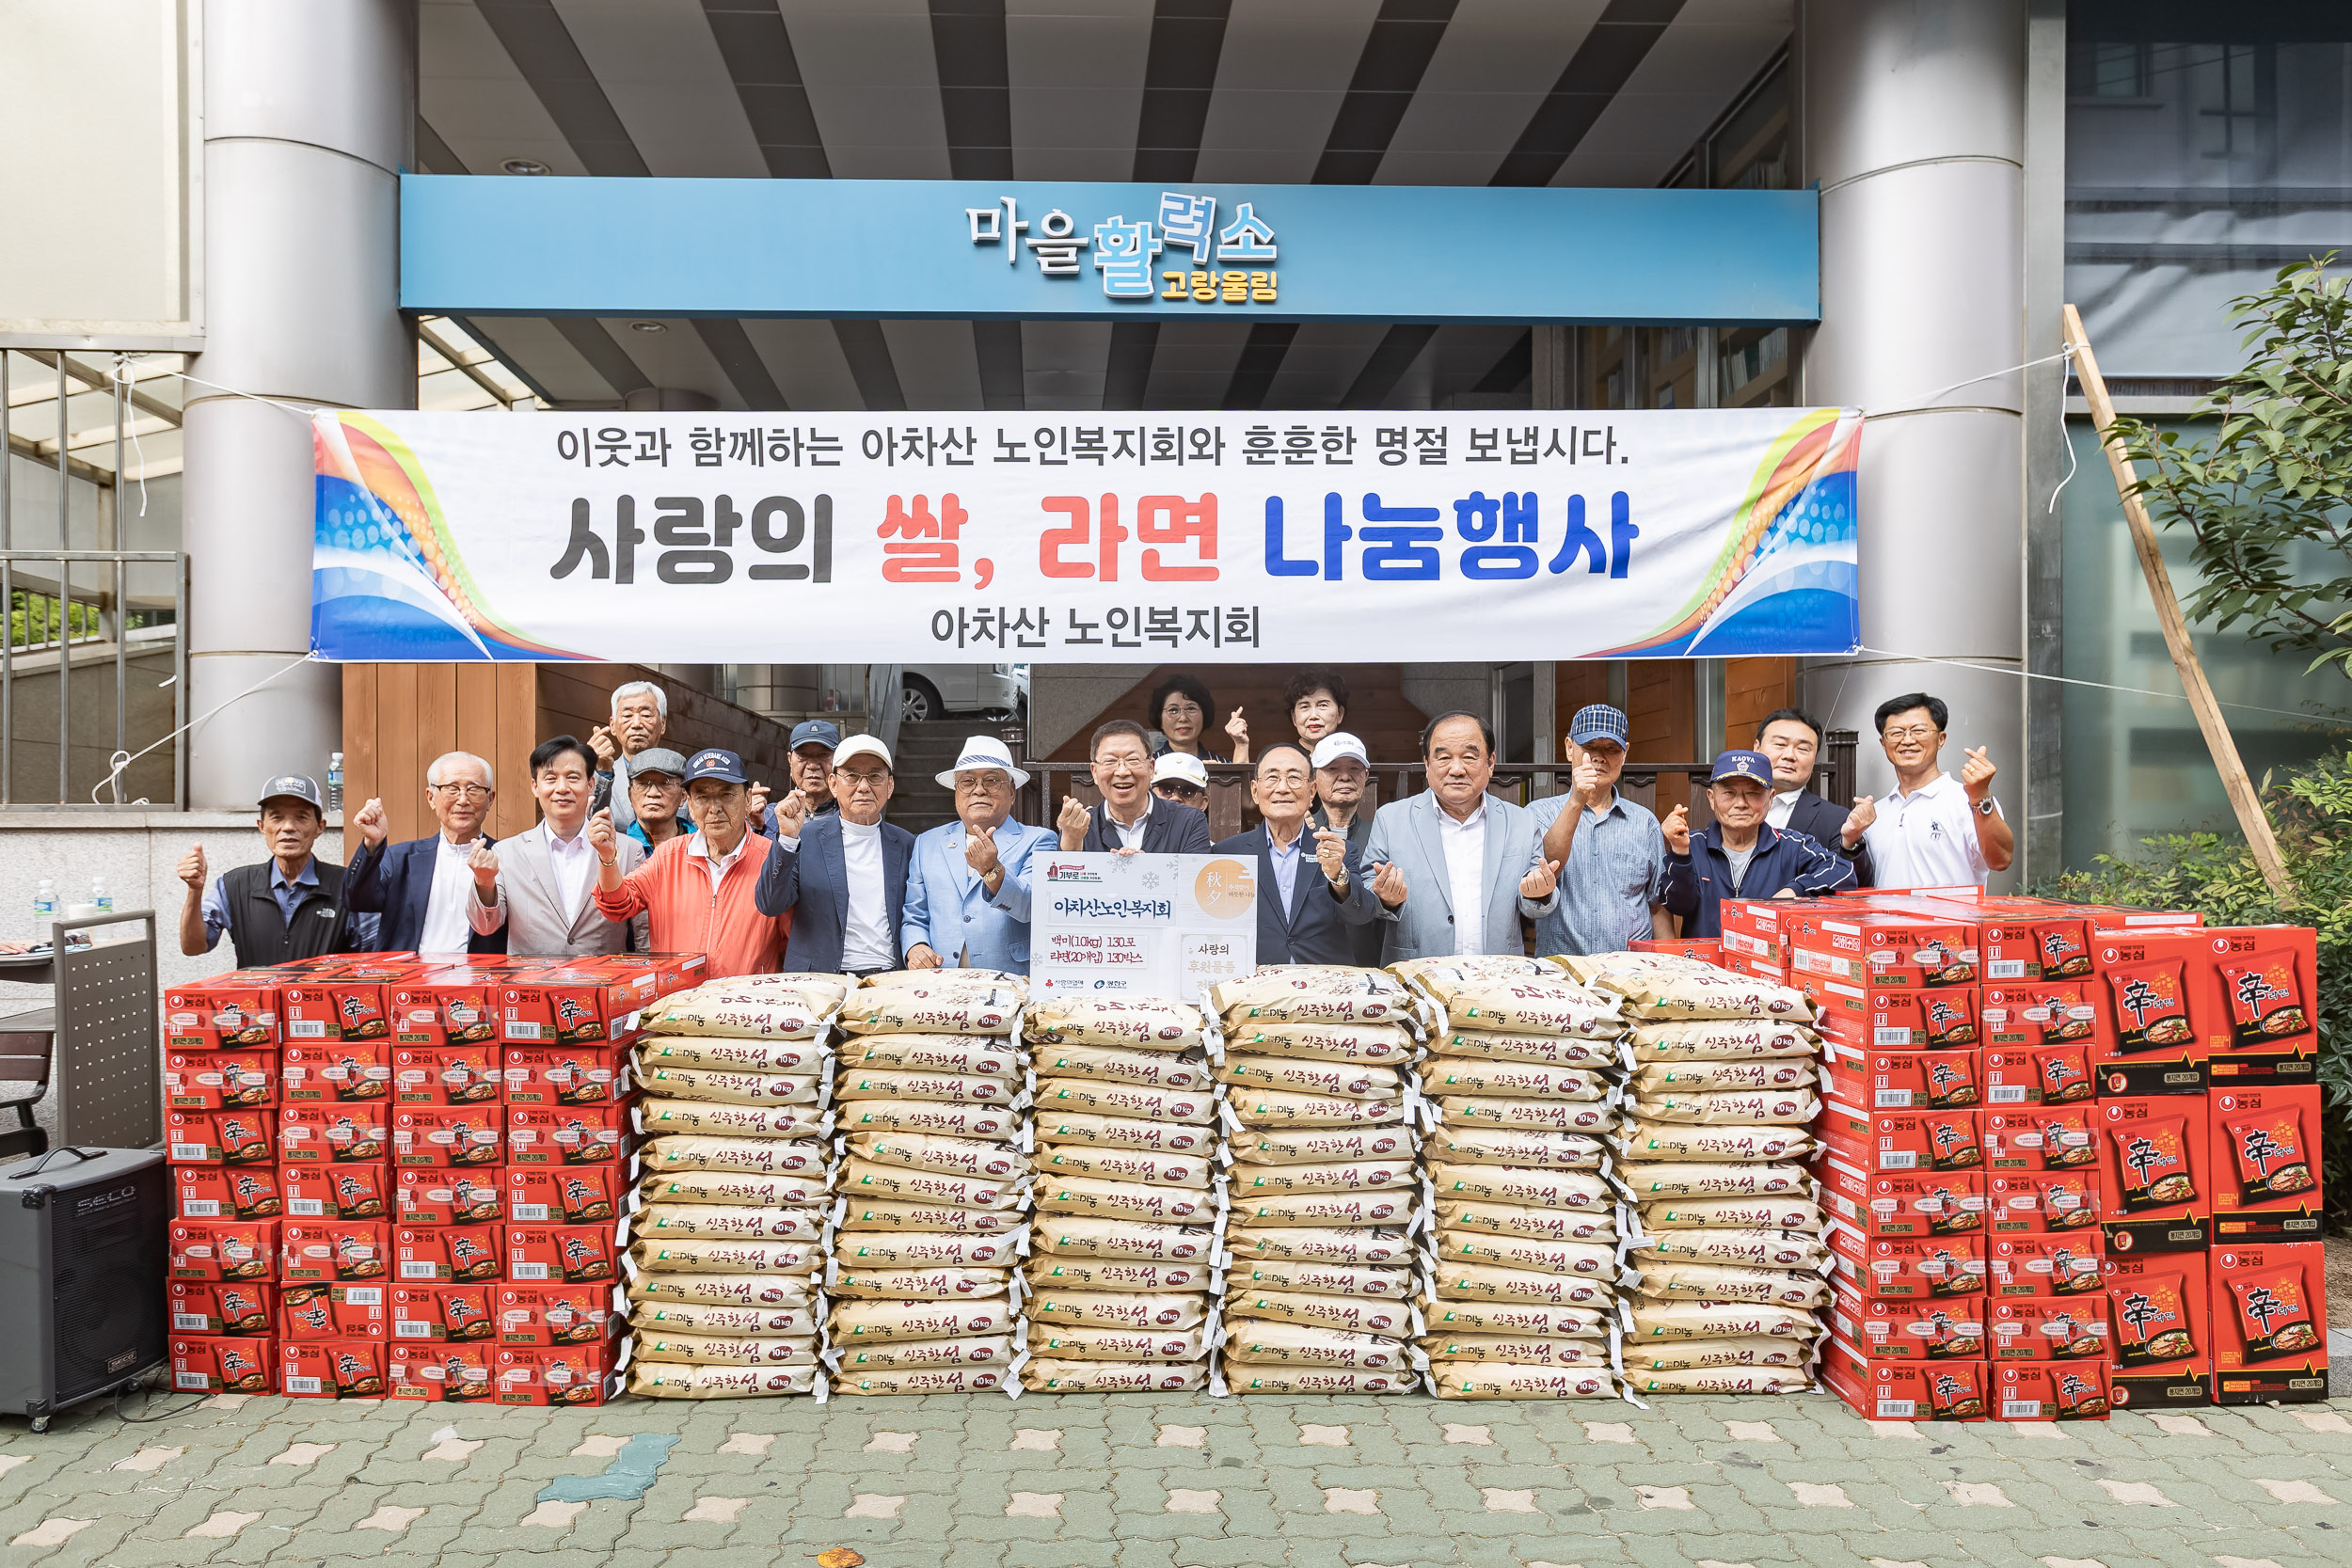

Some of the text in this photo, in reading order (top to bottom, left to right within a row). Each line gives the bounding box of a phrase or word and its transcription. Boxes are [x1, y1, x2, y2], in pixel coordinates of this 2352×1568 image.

[1162, 270, 1278, 302] 고랑울림
[557, 424, 1629, 467] 이웃과 함께하는 아차산 노인복지회와 훈훈한 명절 보냅시다.
[549, 491, 1640, 591] 사랑의 쌀, 라면 나눔행사
[931, 606, 1261, 649] 아차산 노인복지회
[1731, 755, 1756, 764] KAOVA
[1058, 871, 1080, 880] 기부로
[1054, 897, 1171, 921] 아차산노인복지회
[2003, 929, 2025, 940] 농심
[1198, 942, 1230, 956] 사랑의
[2230, 941, 2256, 951] 농심
[1106, 951, 1144, 964] 130박스
[2120, 950, 2145, 960] 농심
[1187, 959, 1237, 974] 후원물품
[184, 997, 204, 1007] 농심
[411, 993, 431, 1004] 농심
[519, 992, 539, 1003] 농심
[1889, 997, 1911, 1007] 농심
[302, 1051, 322, 1061] 농심
[2004, 1055, 2026, 1066] 농심
[2236, 1098, 2262, 1109] 농심
[2123, 1106, 2148, 1118] 농심
[413, 1116, 433, 1126] 농심
[1894, 1120, 1915, 1131] 농심
[197, 1171, 216, 1181] 농심
[301, 1171, 319, 1180] 농심
[78, 1185, 135, 1212] SECO
[526, 1233, 546, 1243] 농심
[1892, 1243, 1914, 1254] 농심
[2013, 1243, 2035, 1254] 농심
[2238, 1256, 2264, 1267] 농심
[2118, 1262, 2144, 1274] 농심
[185, 1287, 203, 1295] 농심
[408, 1291, 428, 1302] 농심
[299, 1348, 319, 1358] 농심
[514, 1354, 533, 1364] 농심
[1893, 1370, 1915, 1380] 농심
[2018, 1370, 2040, 1381] 농심
